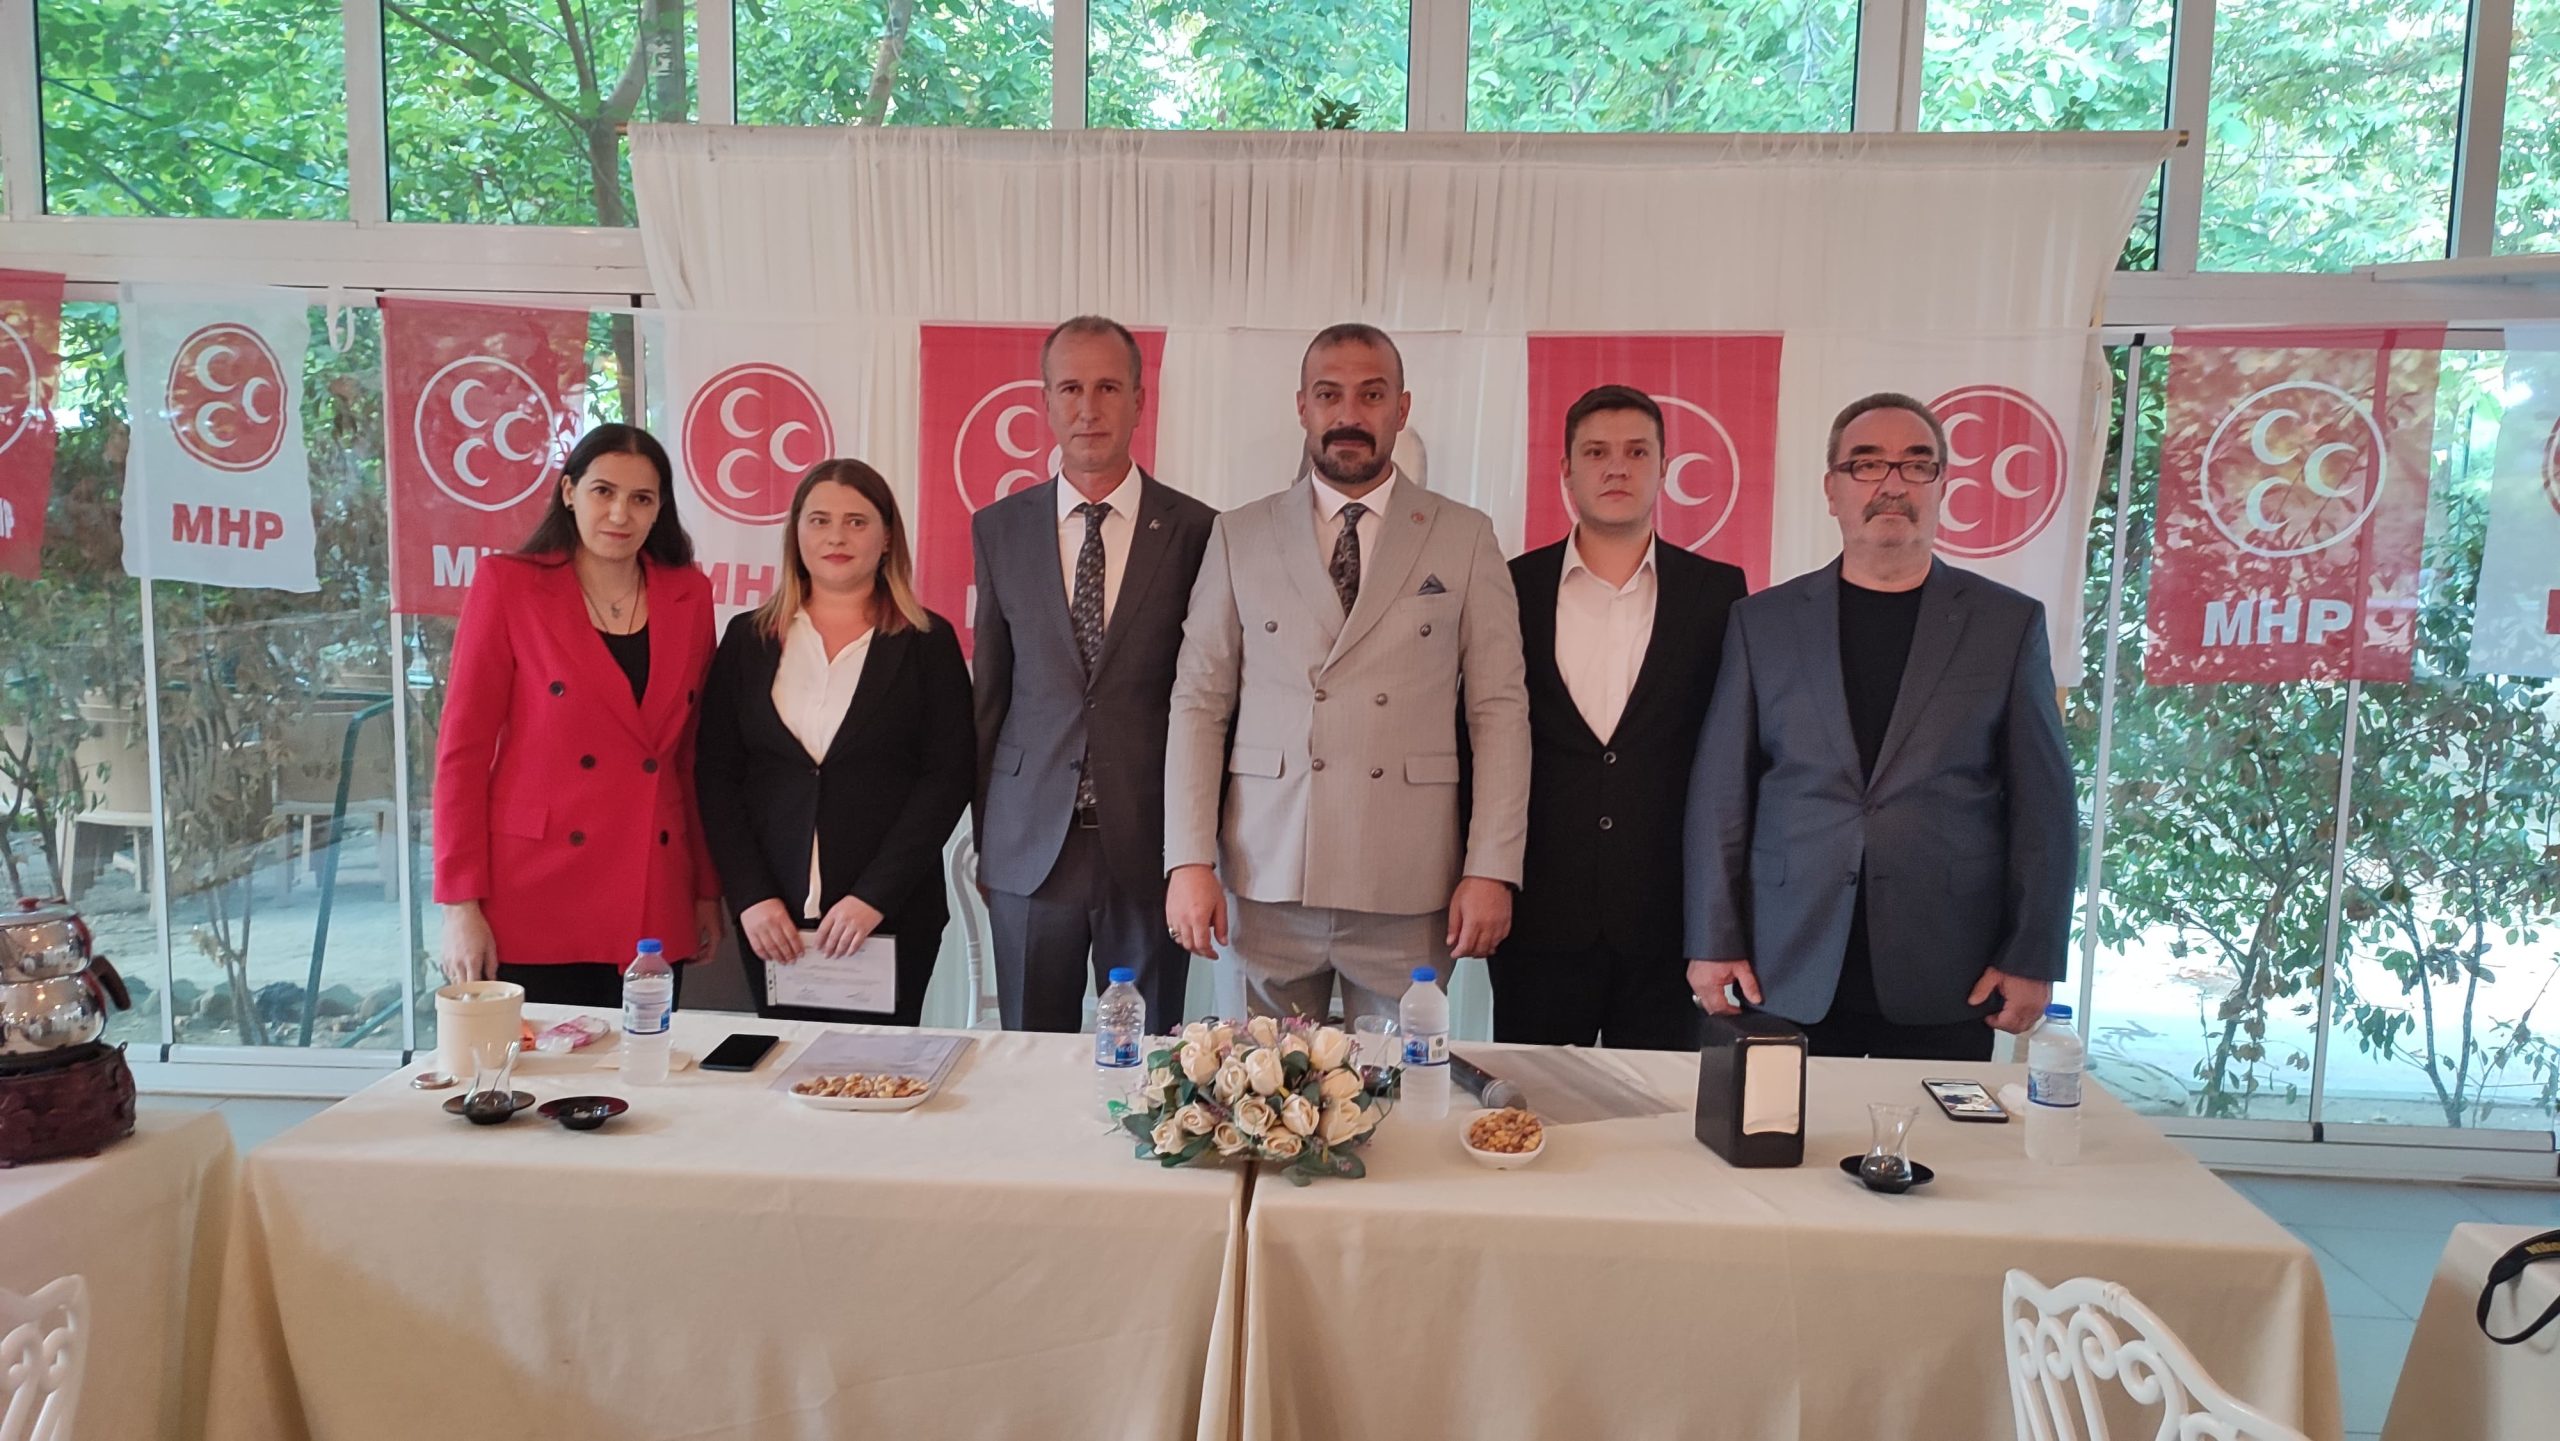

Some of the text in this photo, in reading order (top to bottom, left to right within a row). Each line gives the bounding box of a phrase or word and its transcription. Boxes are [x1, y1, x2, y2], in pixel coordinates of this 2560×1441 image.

[172, 503, 283, 550] MHP
[695, 562, 776, 607] MH
[2201, 597, 2353, 647] MHP
